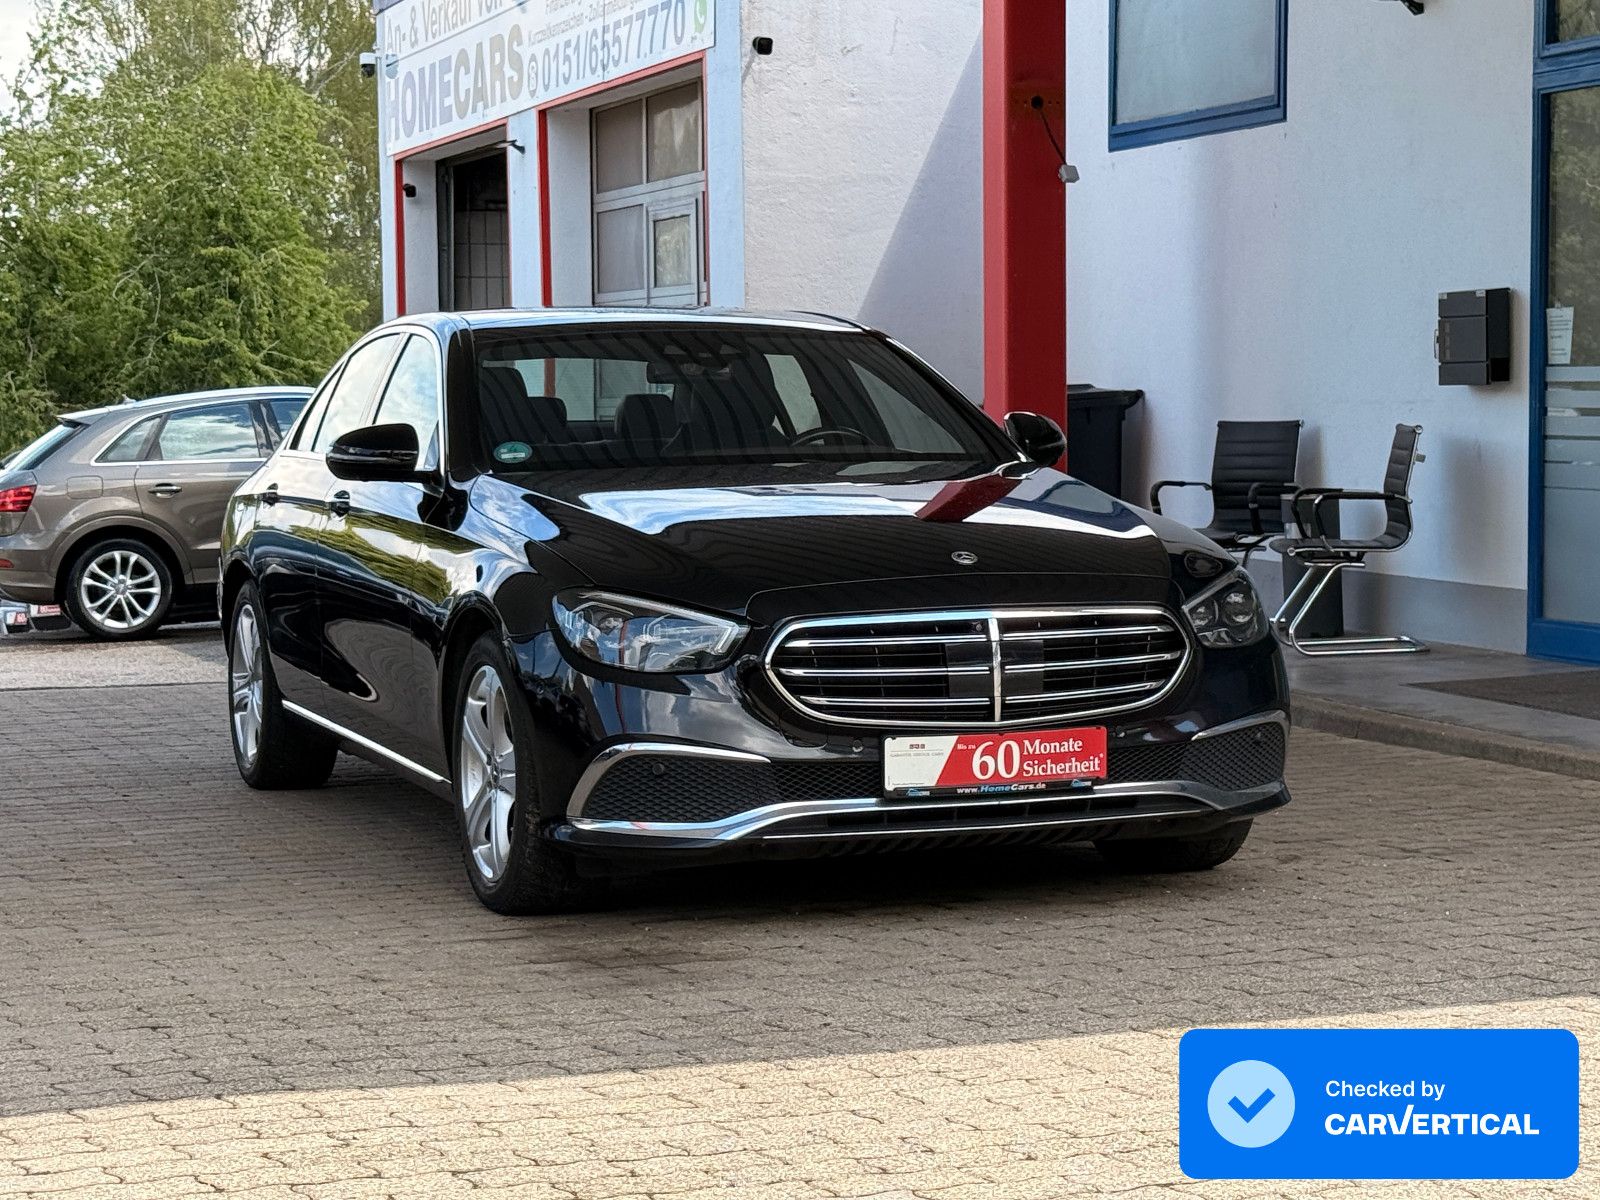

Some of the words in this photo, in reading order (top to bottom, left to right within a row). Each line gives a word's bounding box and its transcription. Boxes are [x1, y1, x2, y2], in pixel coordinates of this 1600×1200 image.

[409, 5, 419, 49] &
[386, 23, 524, 141] HOMECARS
[972, 739, 1020, 780] 60
[1023, 738, 1083, 755] Monate
[1022, 755, 1101, 777] Sicherheit
[956, 782, 1046, 794] www.HomeCars.de
